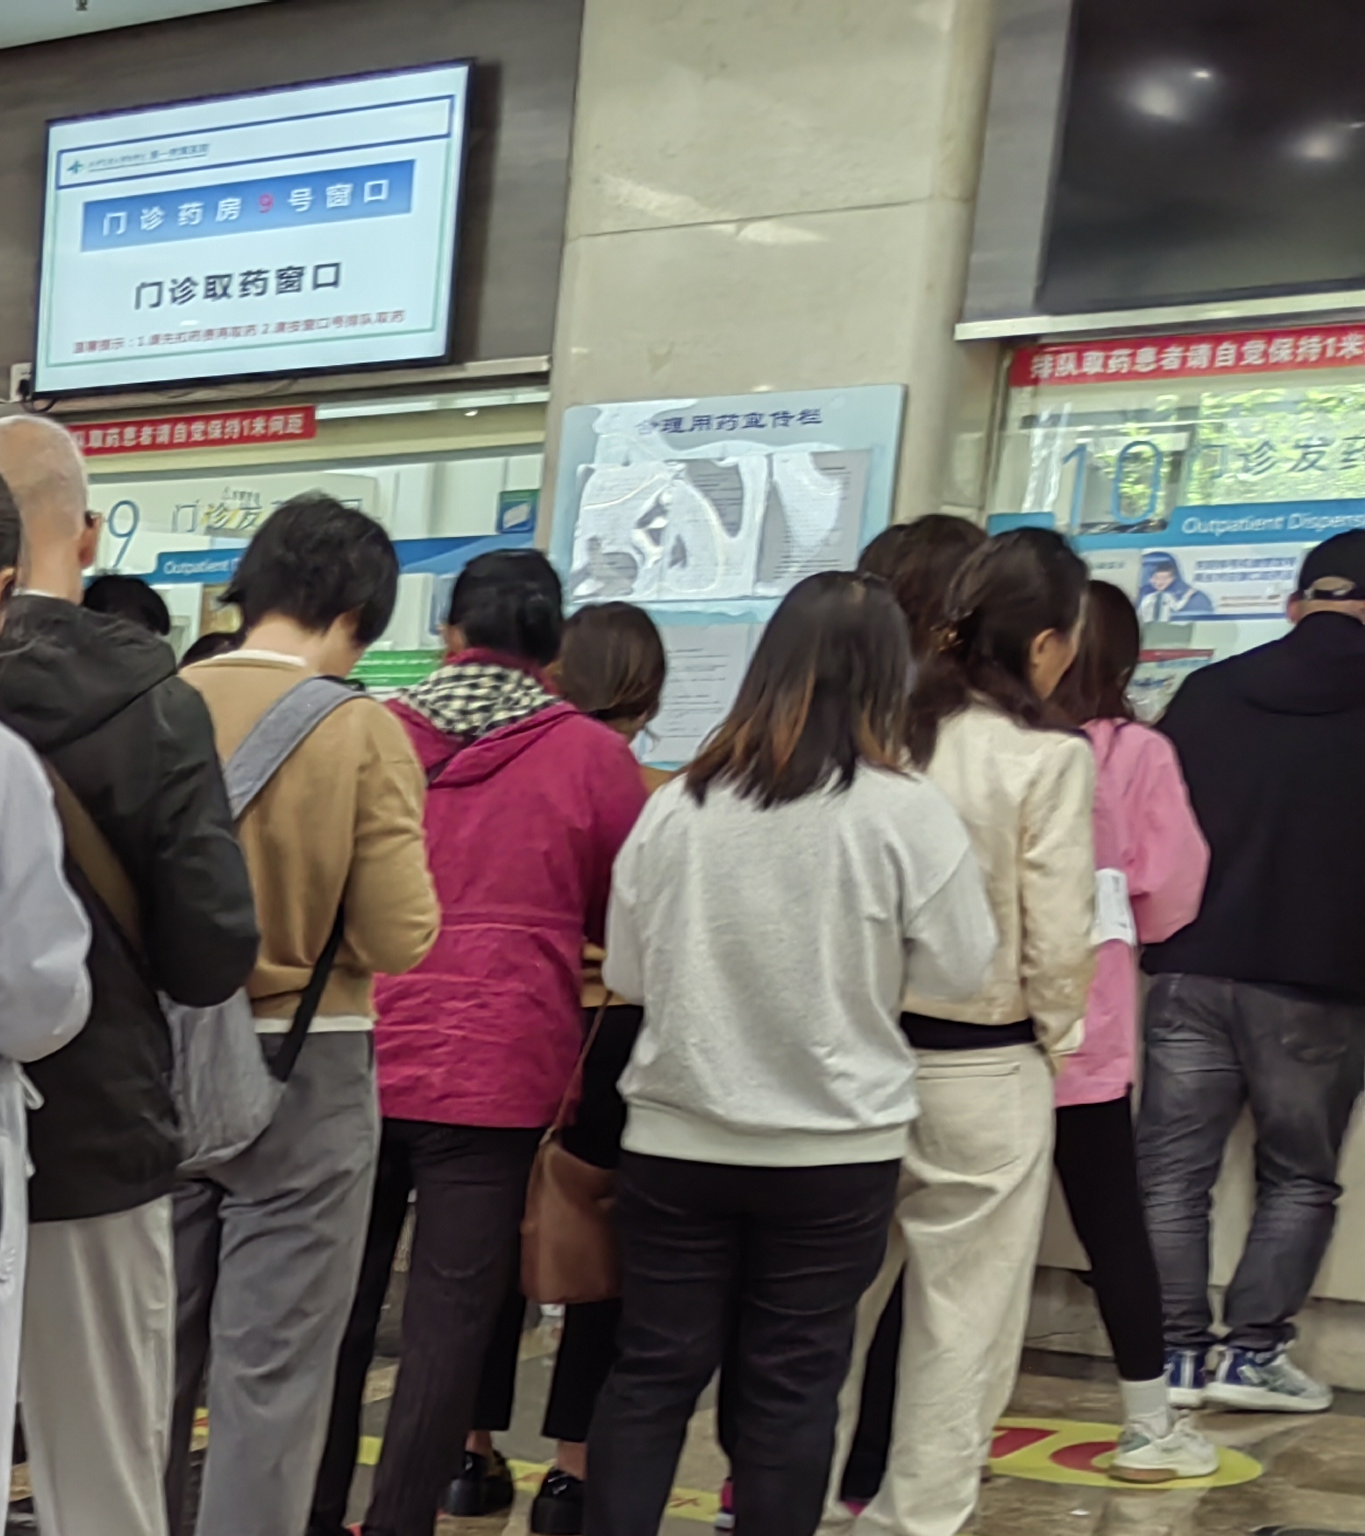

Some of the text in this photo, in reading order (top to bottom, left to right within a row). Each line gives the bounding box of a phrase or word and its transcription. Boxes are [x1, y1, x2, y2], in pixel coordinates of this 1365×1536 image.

[102, 179, 391, 237] 门诊药房9号窗口
[133, 262, 343, 310] 门诊取药窗口
[1062, 440, 1162, 532] 10
[108, 500, 140, 569] 9
